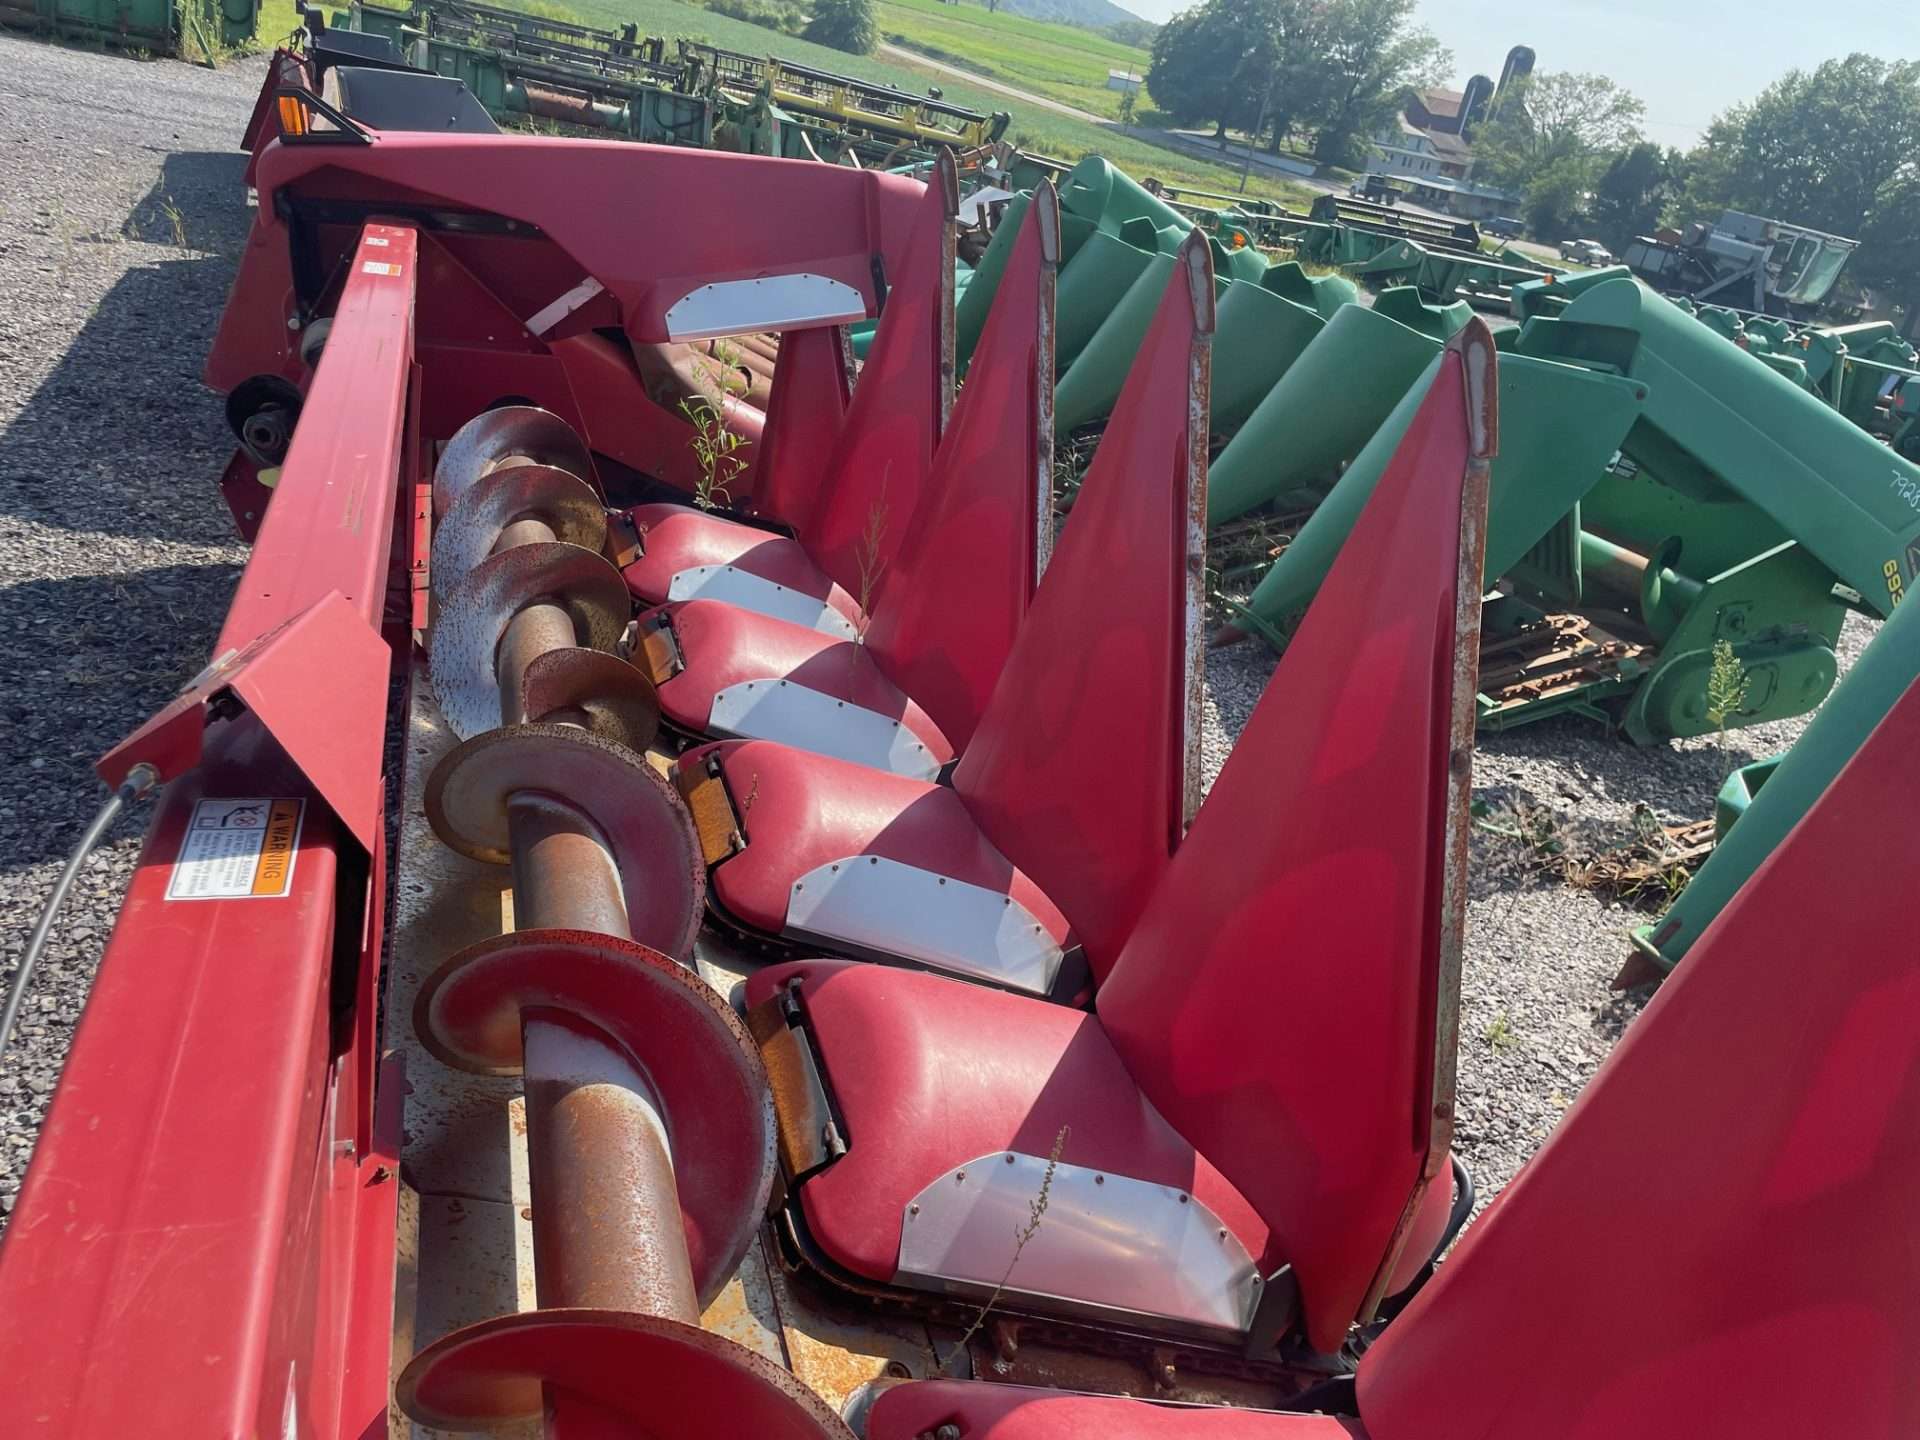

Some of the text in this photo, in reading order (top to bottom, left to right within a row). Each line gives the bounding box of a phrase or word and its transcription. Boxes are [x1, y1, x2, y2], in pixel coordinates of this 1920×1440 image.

[1889, 469, 1920, 514] 7928
[1883, 558, 1905, 609] 693
[262, 826, 290, 880] WARNING
